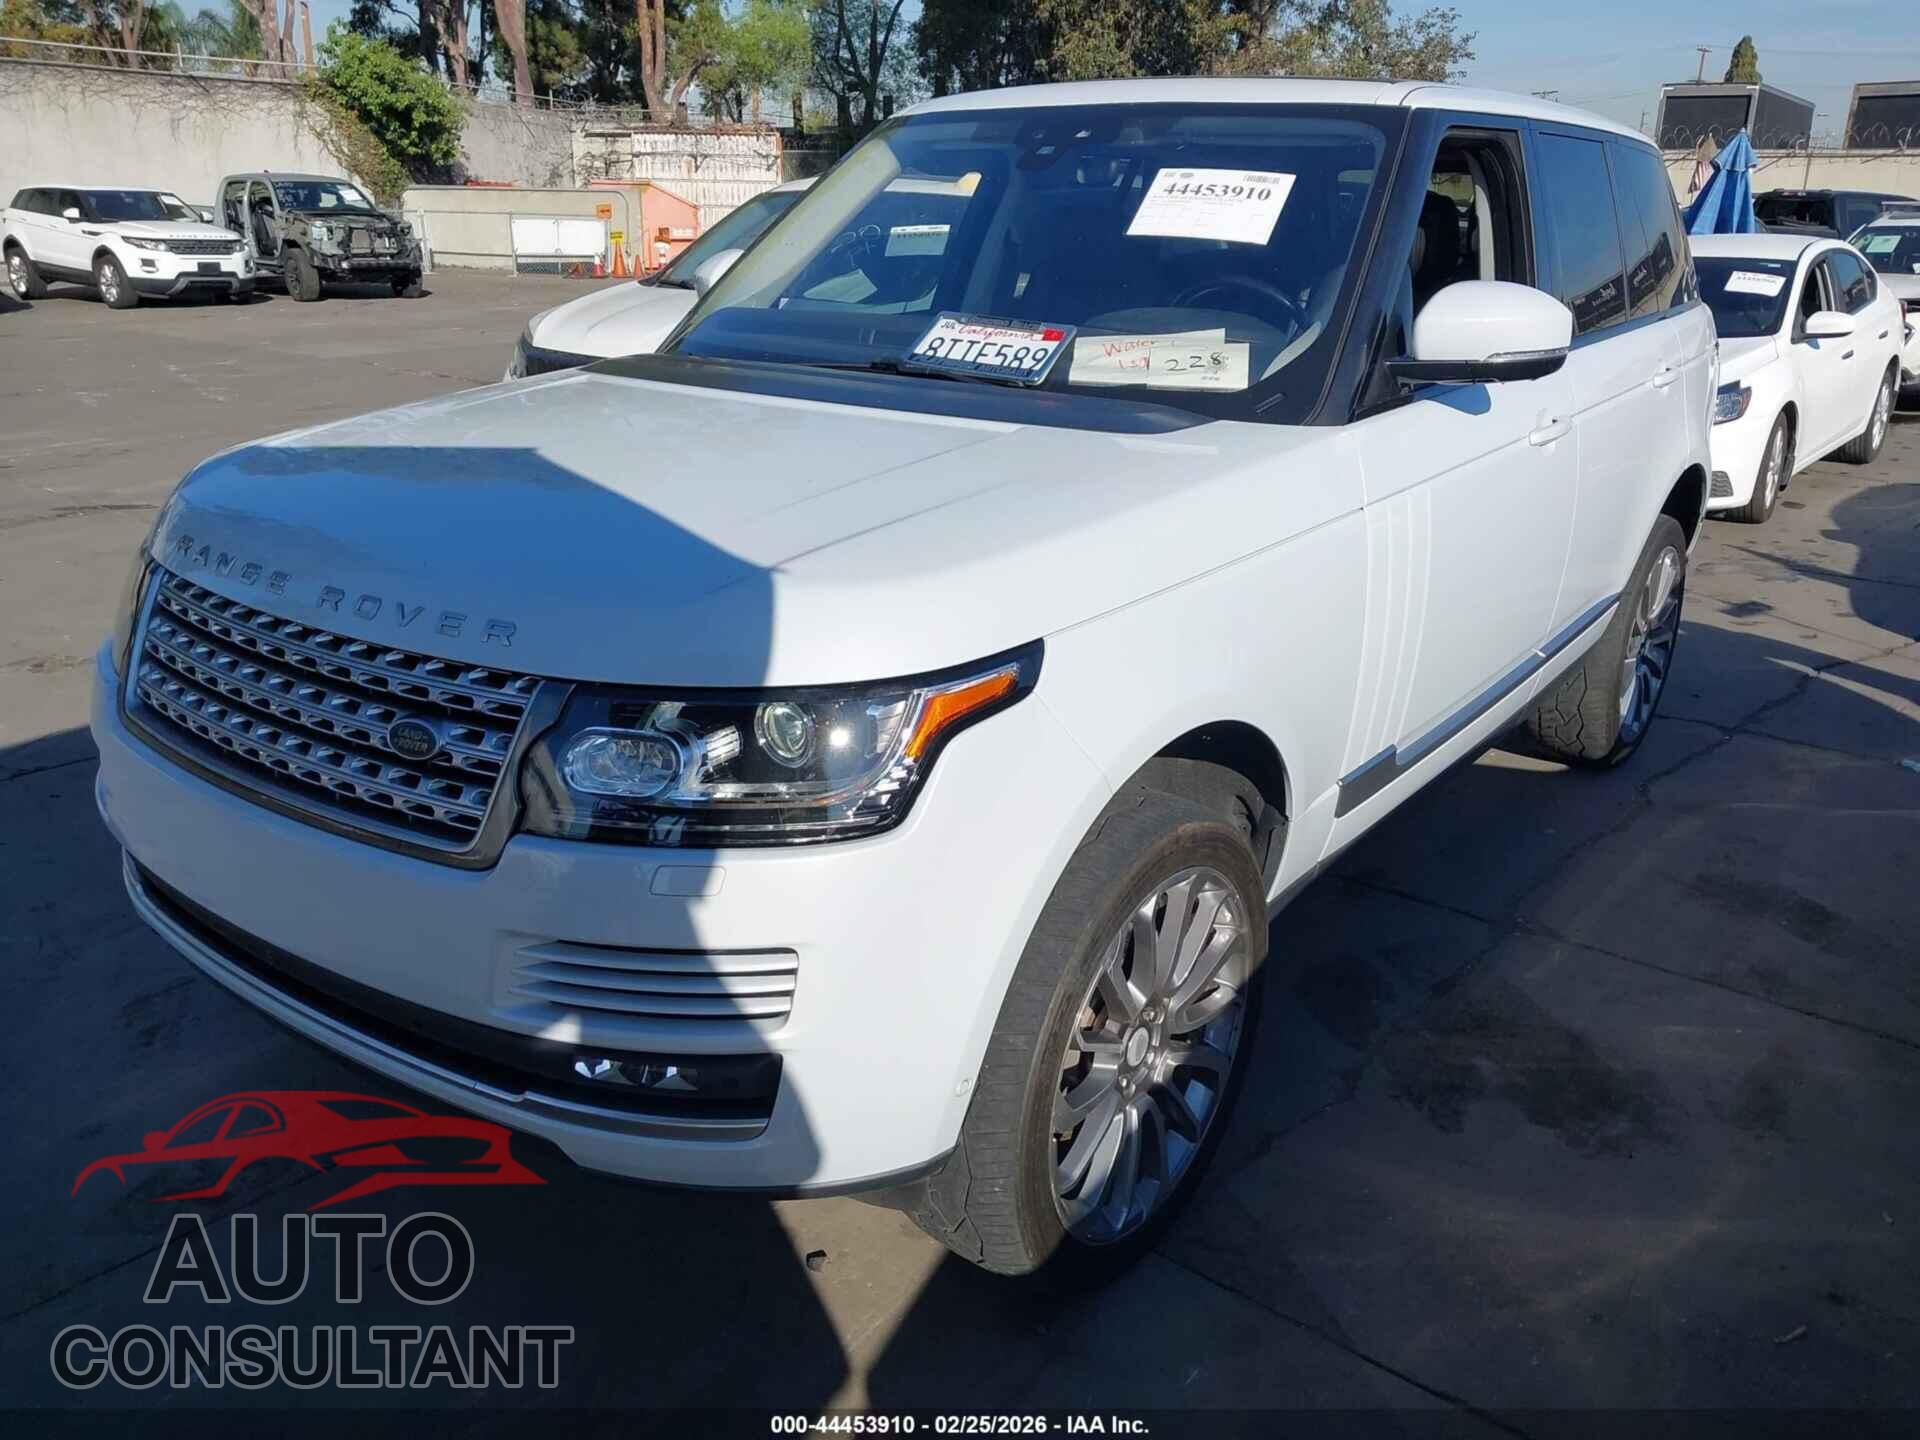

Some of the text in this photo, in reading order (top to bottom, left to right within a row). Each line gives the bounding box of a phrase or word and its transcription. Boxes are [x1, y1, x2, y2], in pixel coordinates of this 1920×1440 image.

[1163, 182, 1272, 201] 44453910
[940, 320, 957, 330] JUL
[958, 323, 1036, 340] California
[175, 534, 518, 648] RANGE ROVER
